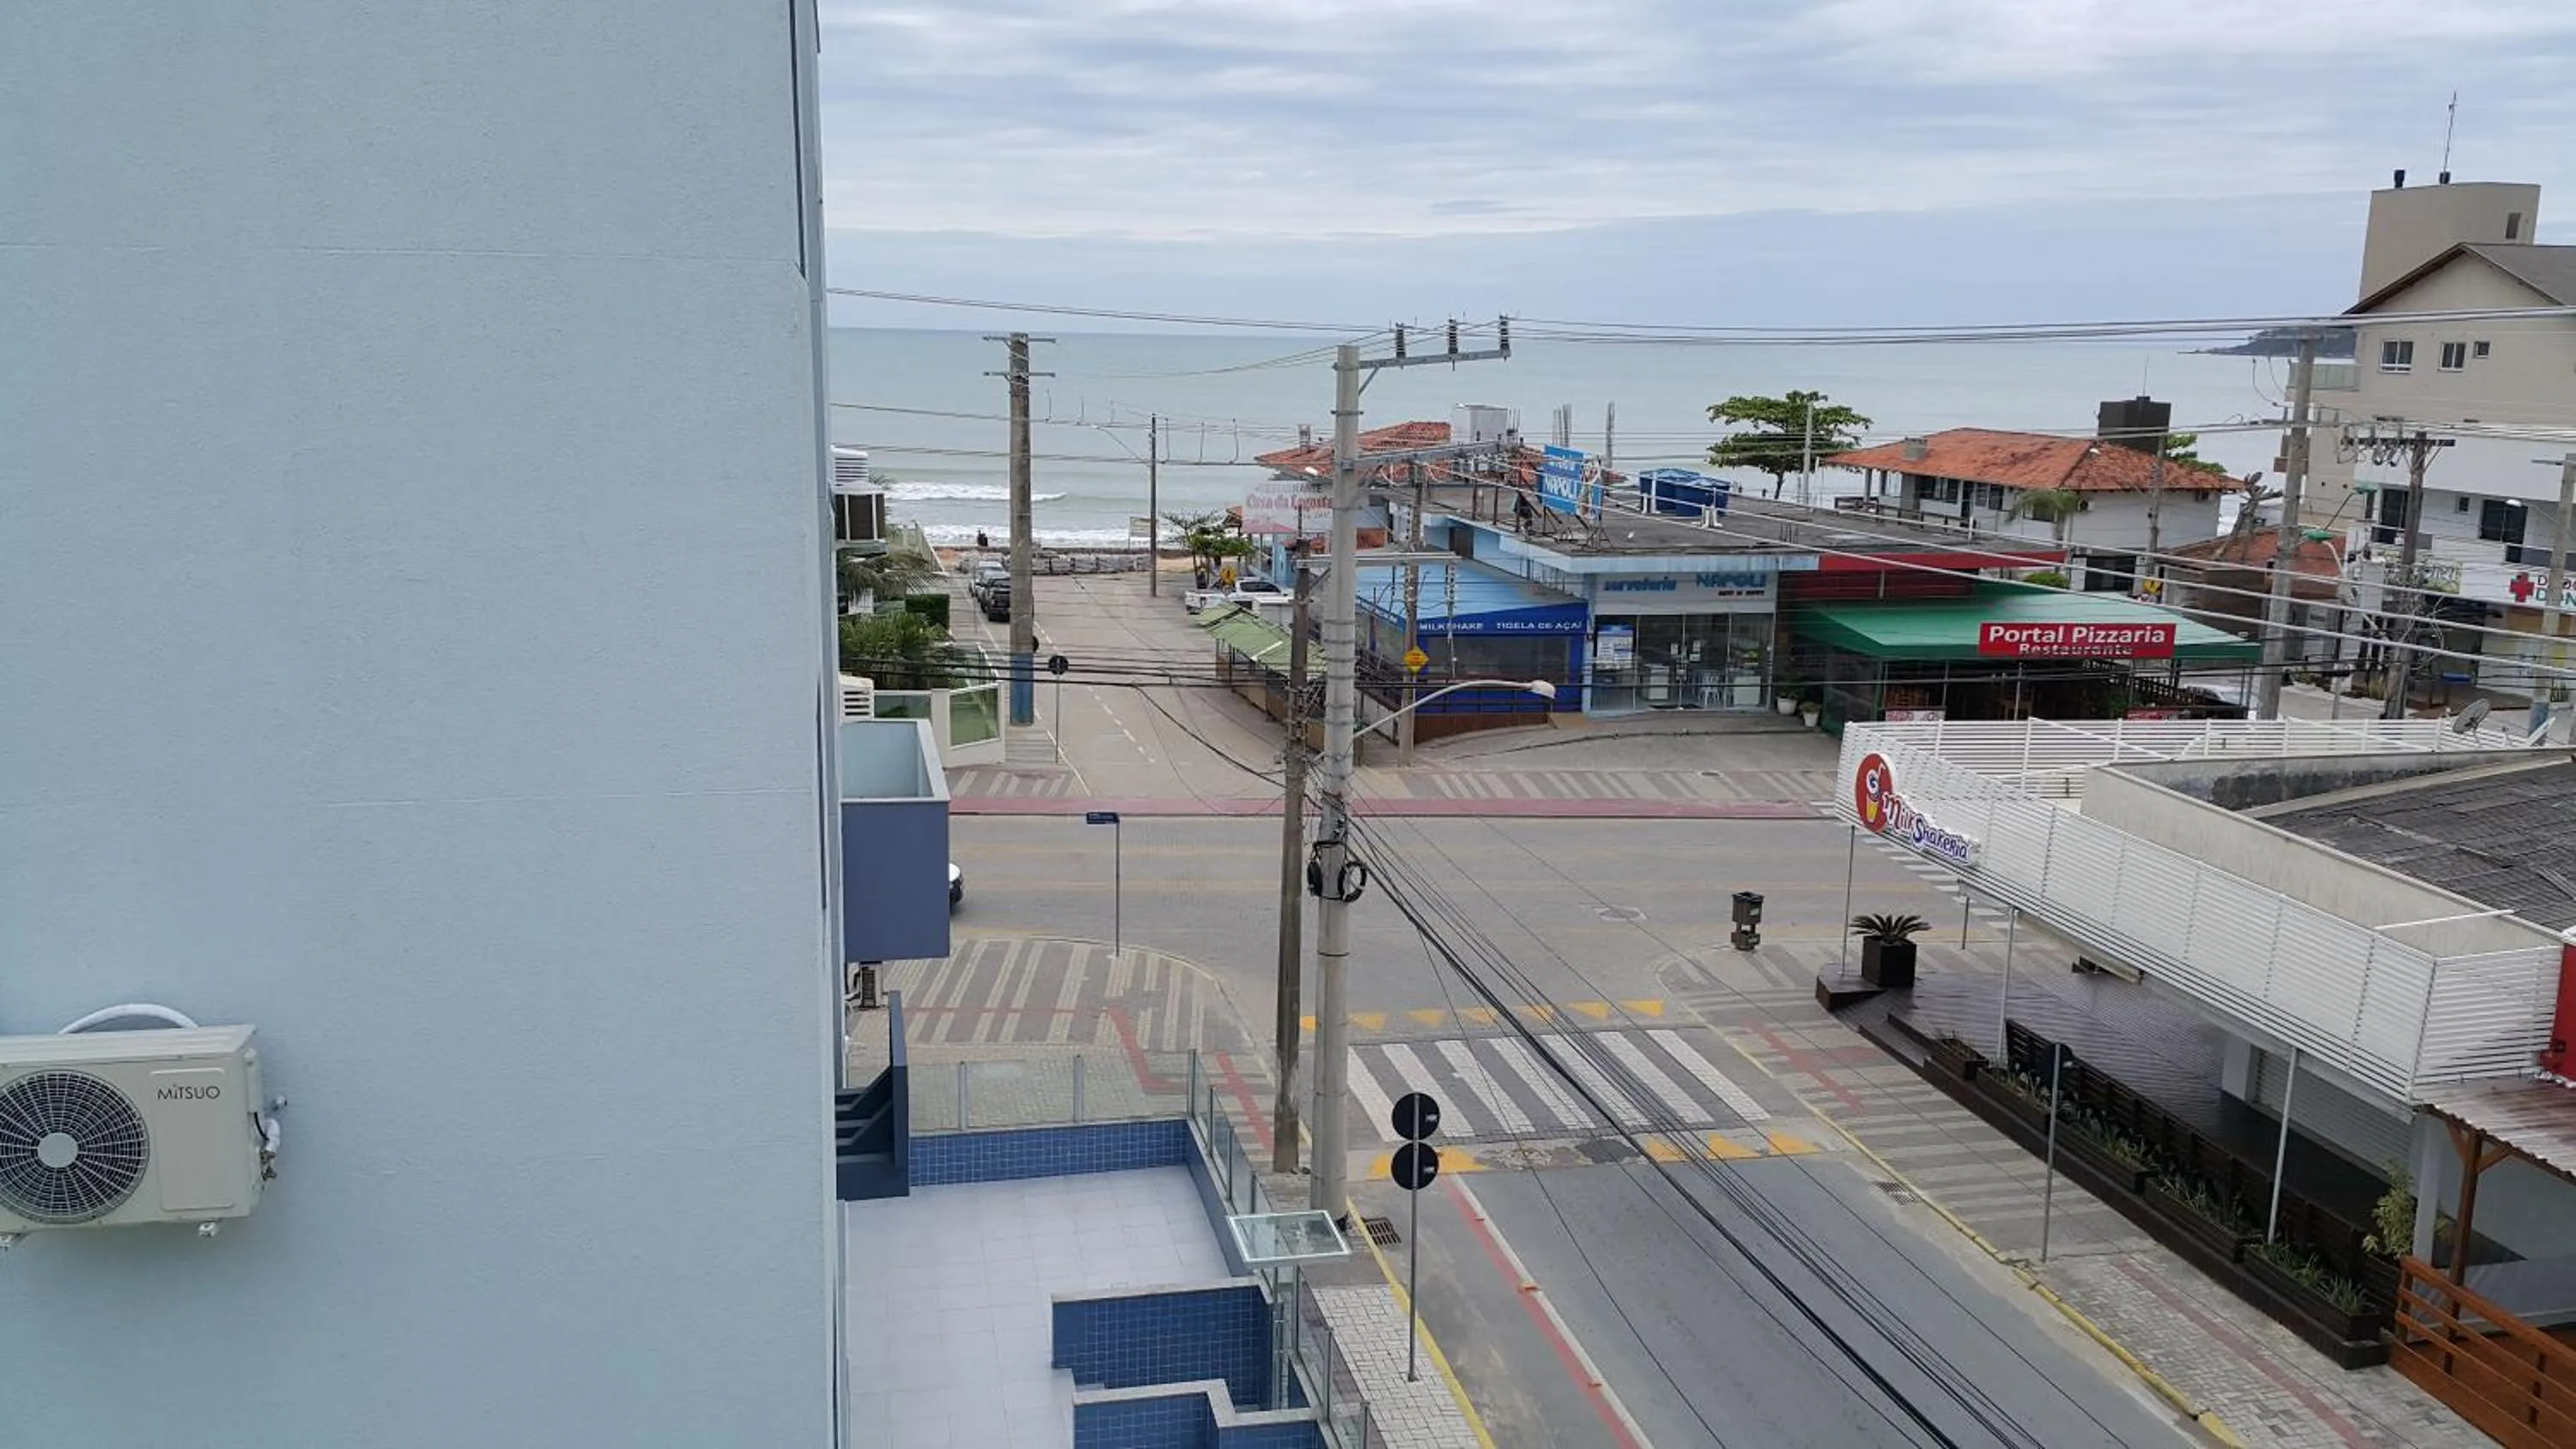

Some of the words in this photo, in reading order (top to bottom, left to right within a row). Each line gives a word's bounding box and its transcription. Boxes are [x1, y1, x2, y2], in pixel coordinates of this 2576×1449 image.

[1989, 626, 2064, 643] Portal
[2072, 626, 2166, 644] Pizzaria
[2019, 643, 2134, 656] Restaurante
